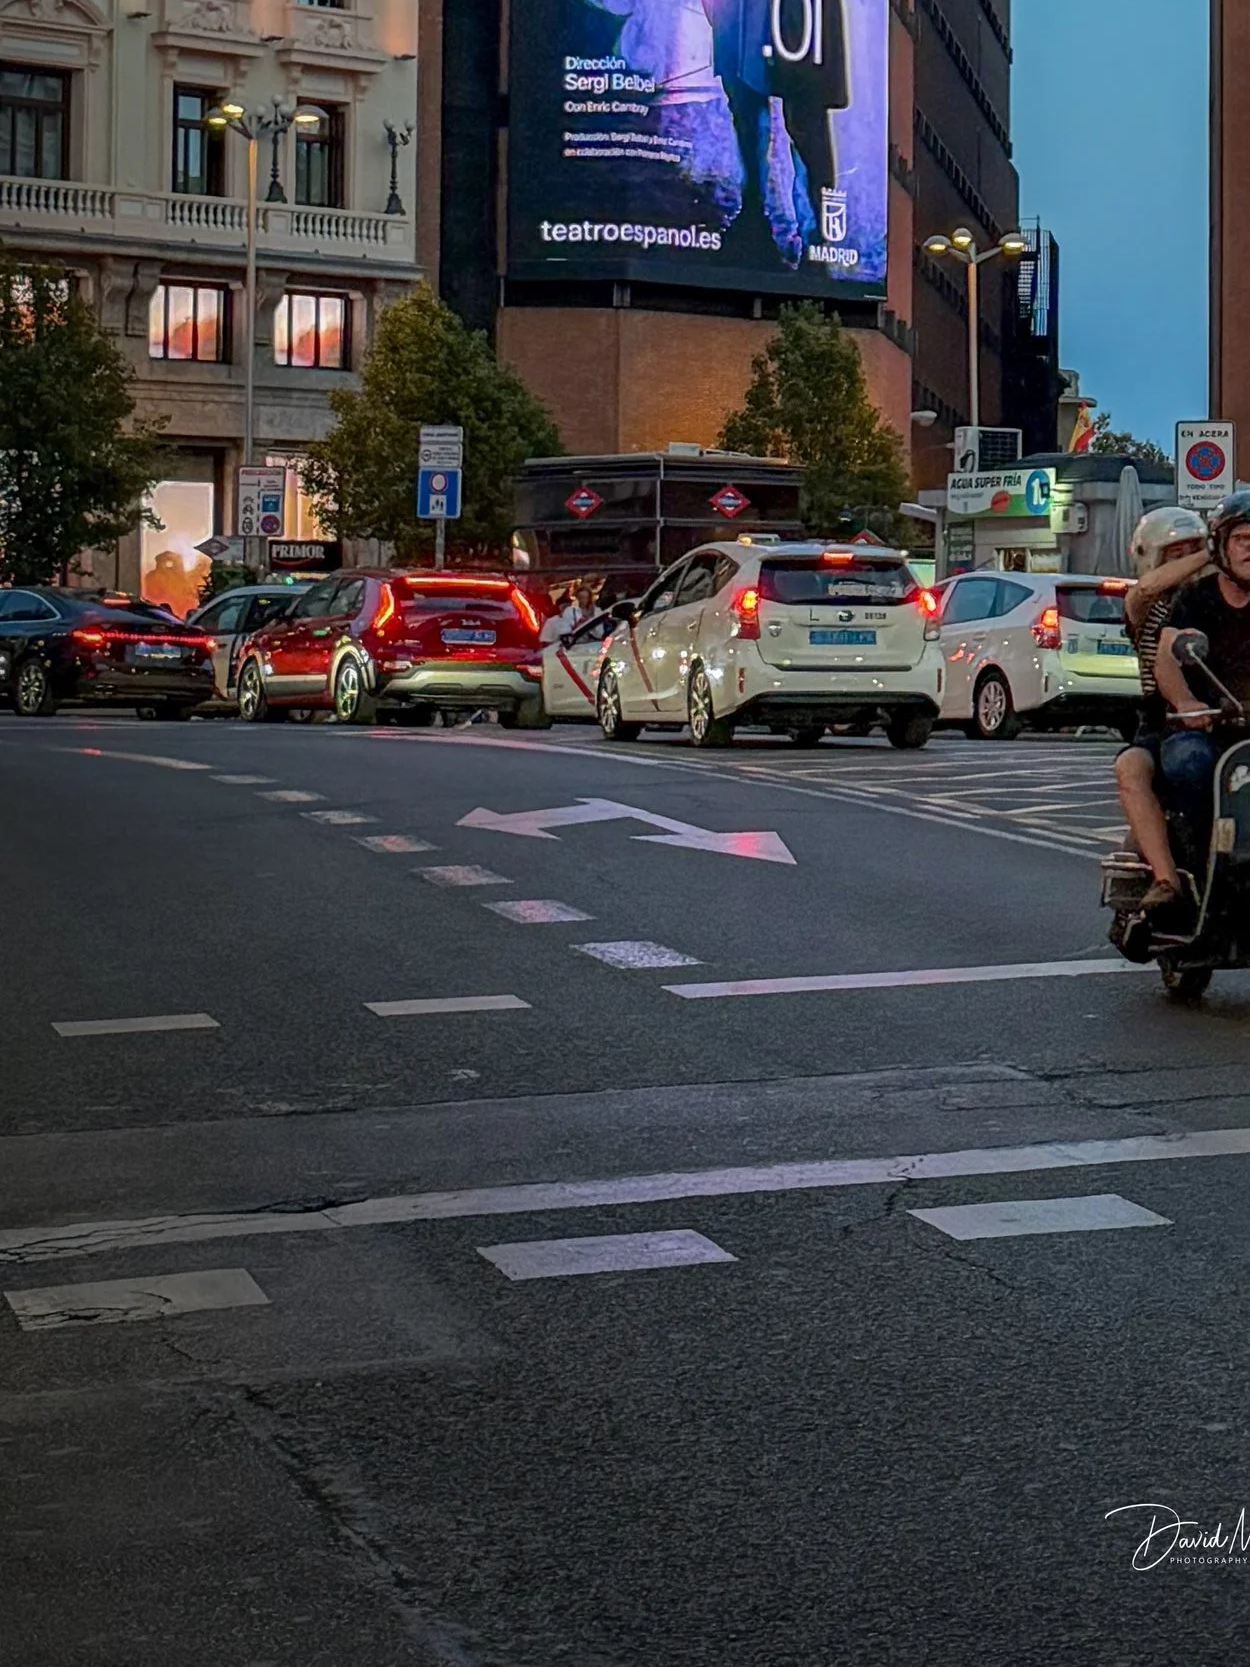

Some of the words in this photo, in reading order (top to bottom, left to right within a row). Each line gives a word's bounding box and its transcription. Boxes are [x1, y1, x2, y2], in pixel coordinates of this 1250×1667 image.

[565, 56, 626, 70] Dirección
[541, 221, 722, 251] teatroespanol.es
[809, 245, 859, 267] MADRID
[1181, 430, 1194, 438] EN
[1199, 430, 1229, 438] ACERA
[974, 476, 1001, 488] SUPER
[1003, 472, 1022, 487] FRÍA
[272, 544, 325, 559] PRIMOR
